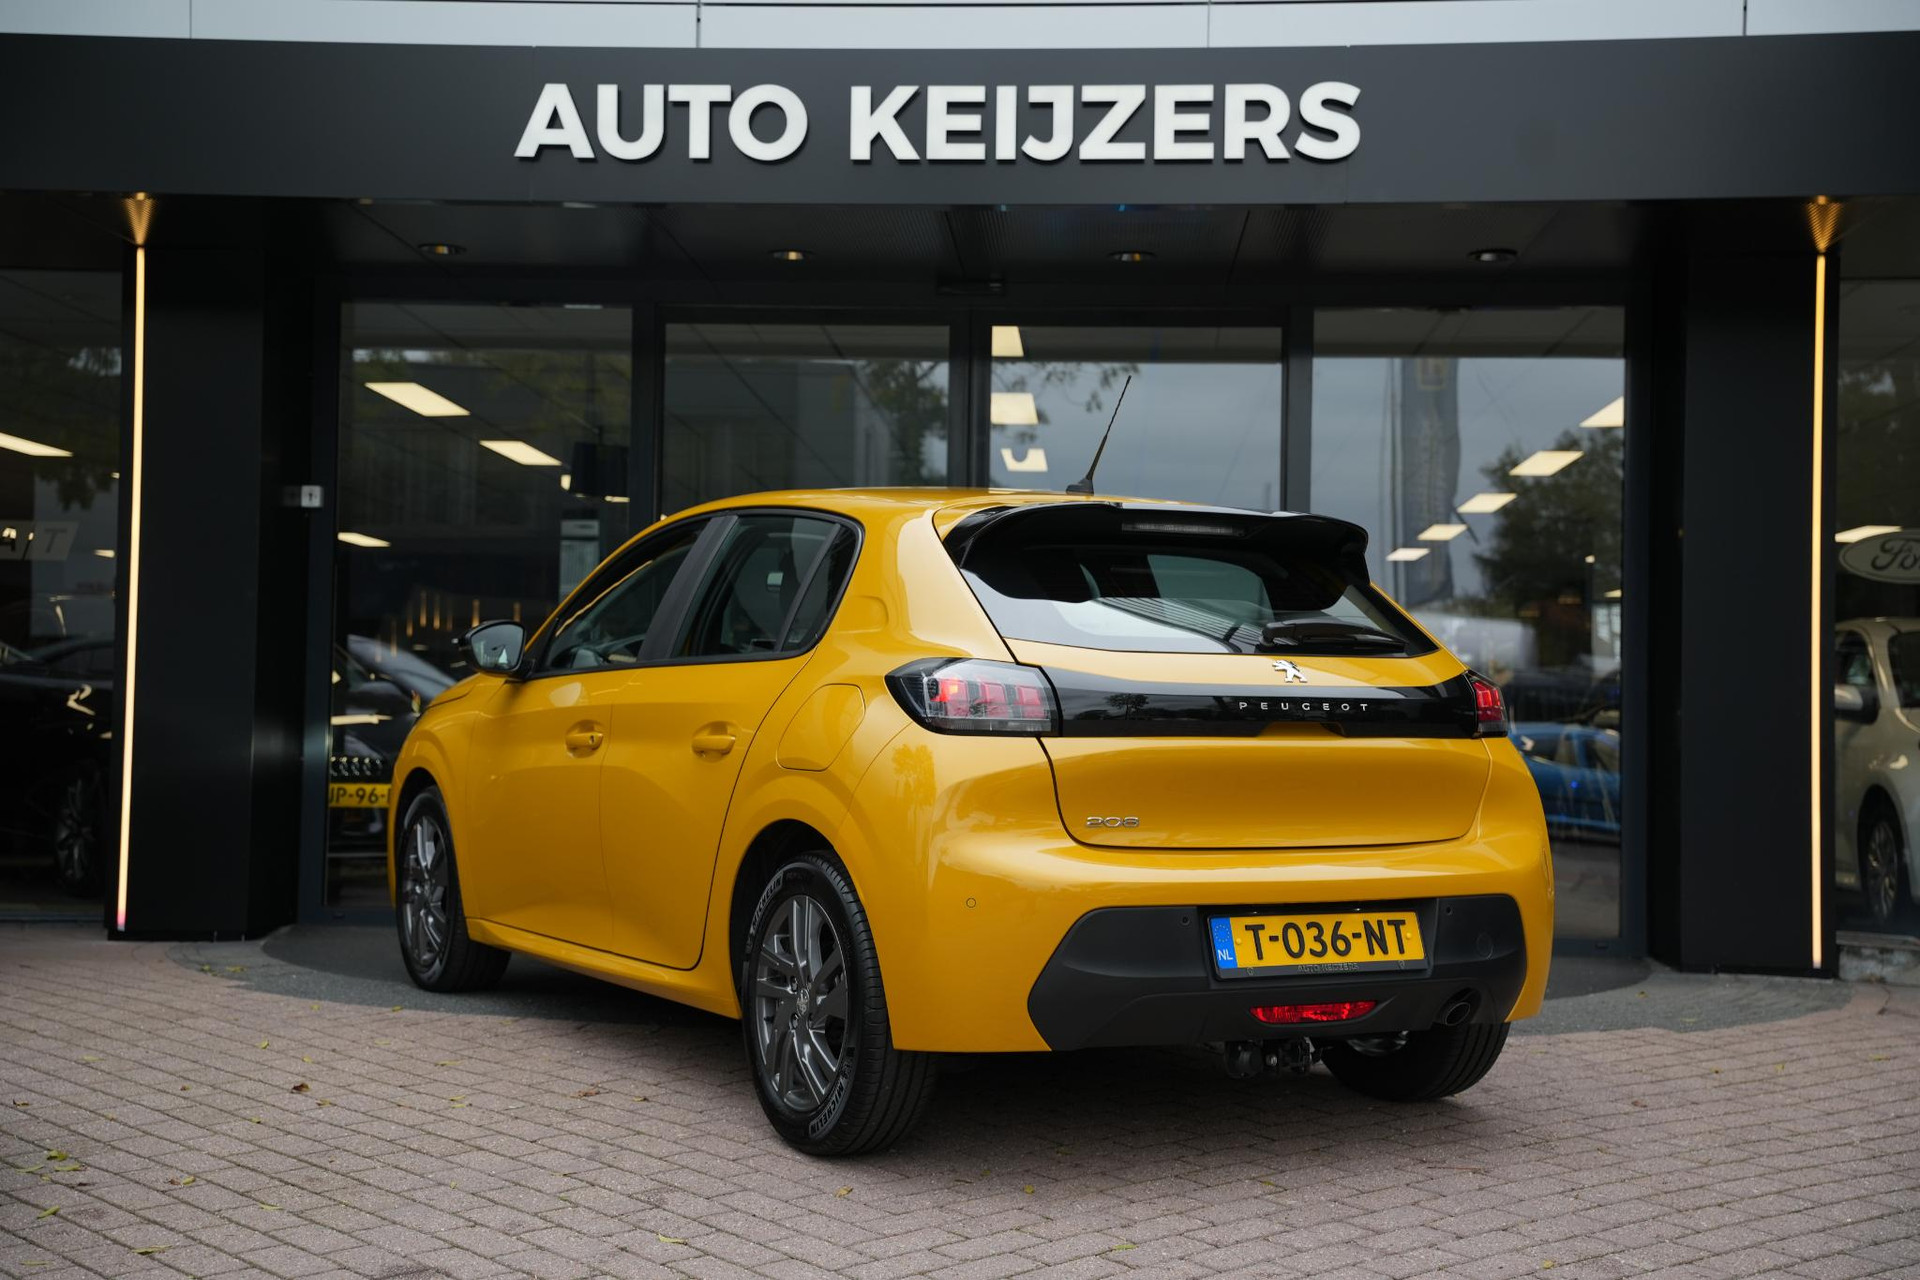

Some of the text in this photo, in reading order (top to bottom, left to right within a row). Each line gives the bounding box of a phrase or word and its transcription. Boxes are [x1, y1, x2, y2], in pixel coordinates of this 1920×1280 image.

[514, 81, 1361, 163] AUTO KEIJZERS
[1871, 538, 1920, 570] Fo
[1239, 702, 1368, 711] PEUGEOT
[1086, 816, 1140, 828] 208
[1245, 919, 1406, 960] T-036-NT
[1217, 949, 1233, 961] NL
